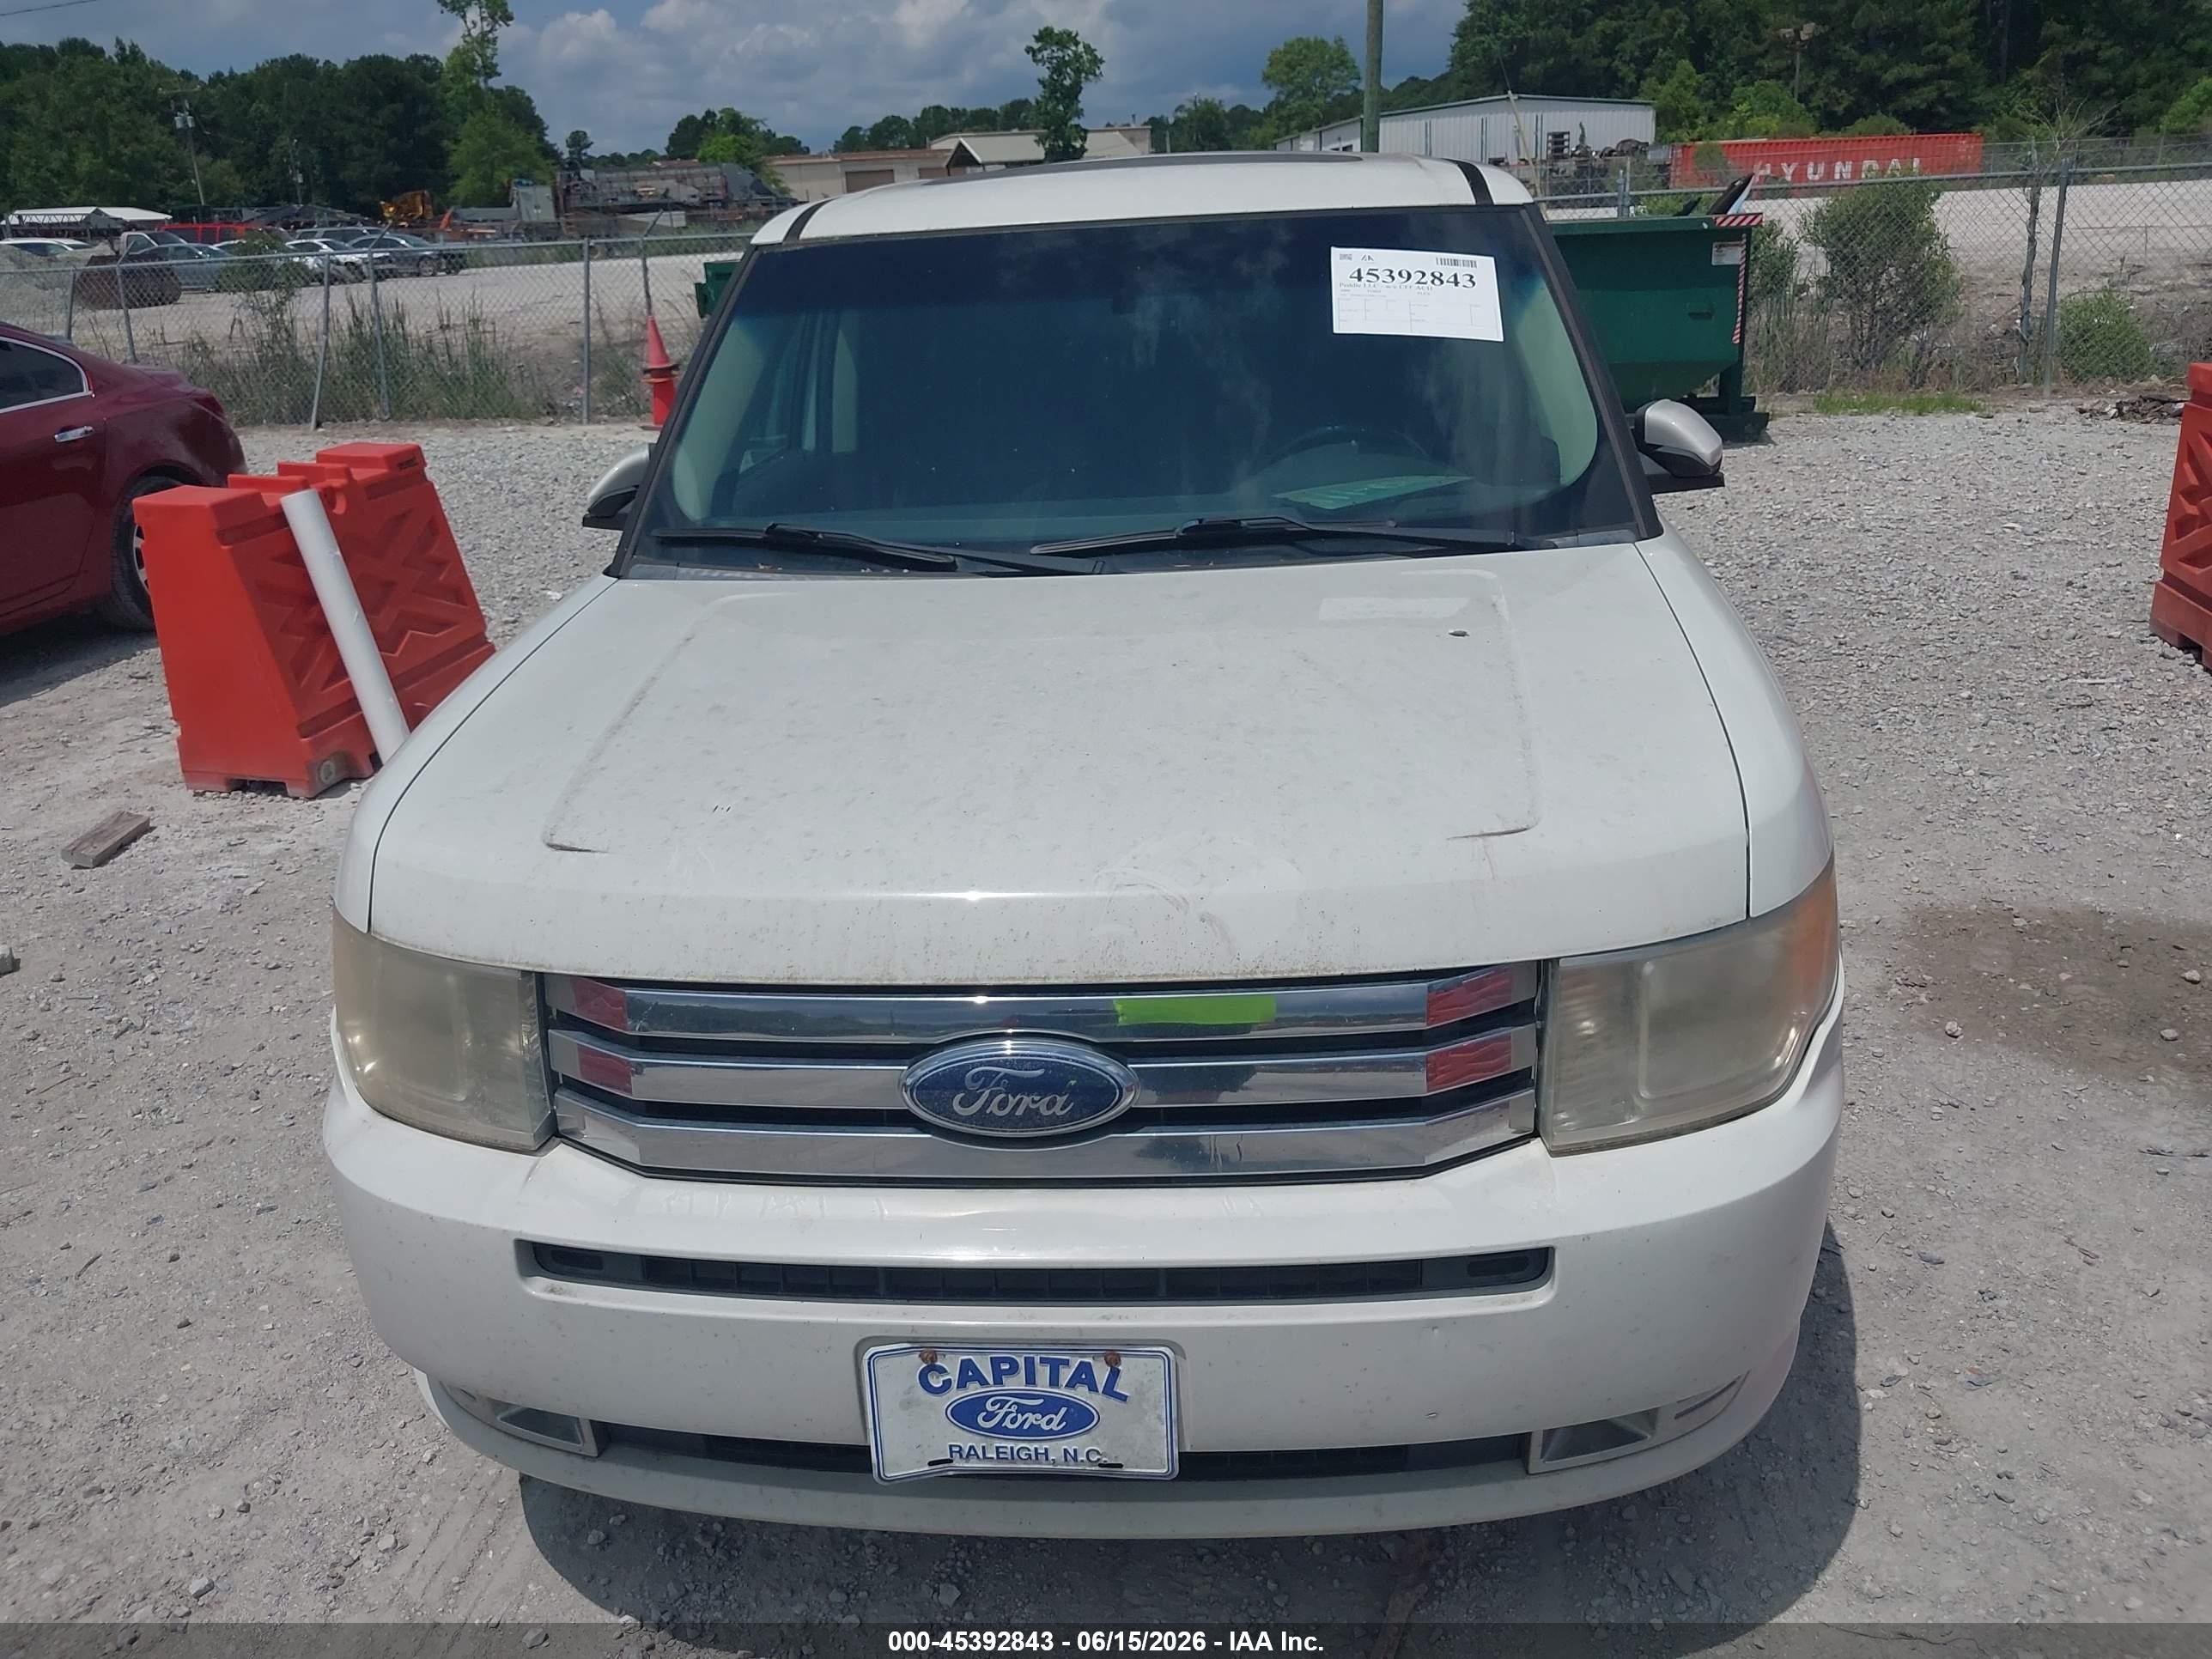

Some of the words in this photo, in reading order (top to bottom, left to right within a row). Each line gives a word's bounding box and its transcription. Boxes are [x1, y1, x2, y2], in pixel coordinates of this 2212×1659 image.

[1753, 158, 1921, 183] HYUNDAI
[1349, 267, 1476, 289] 45392843
[952, 1066, 1077, 1116] Ford
[917, 1354, 1130, 1403] CAPITAL
[976, 1395, 1068, 1431] Ford
[948, 1444, 1057, 1465] RALEIGH,
